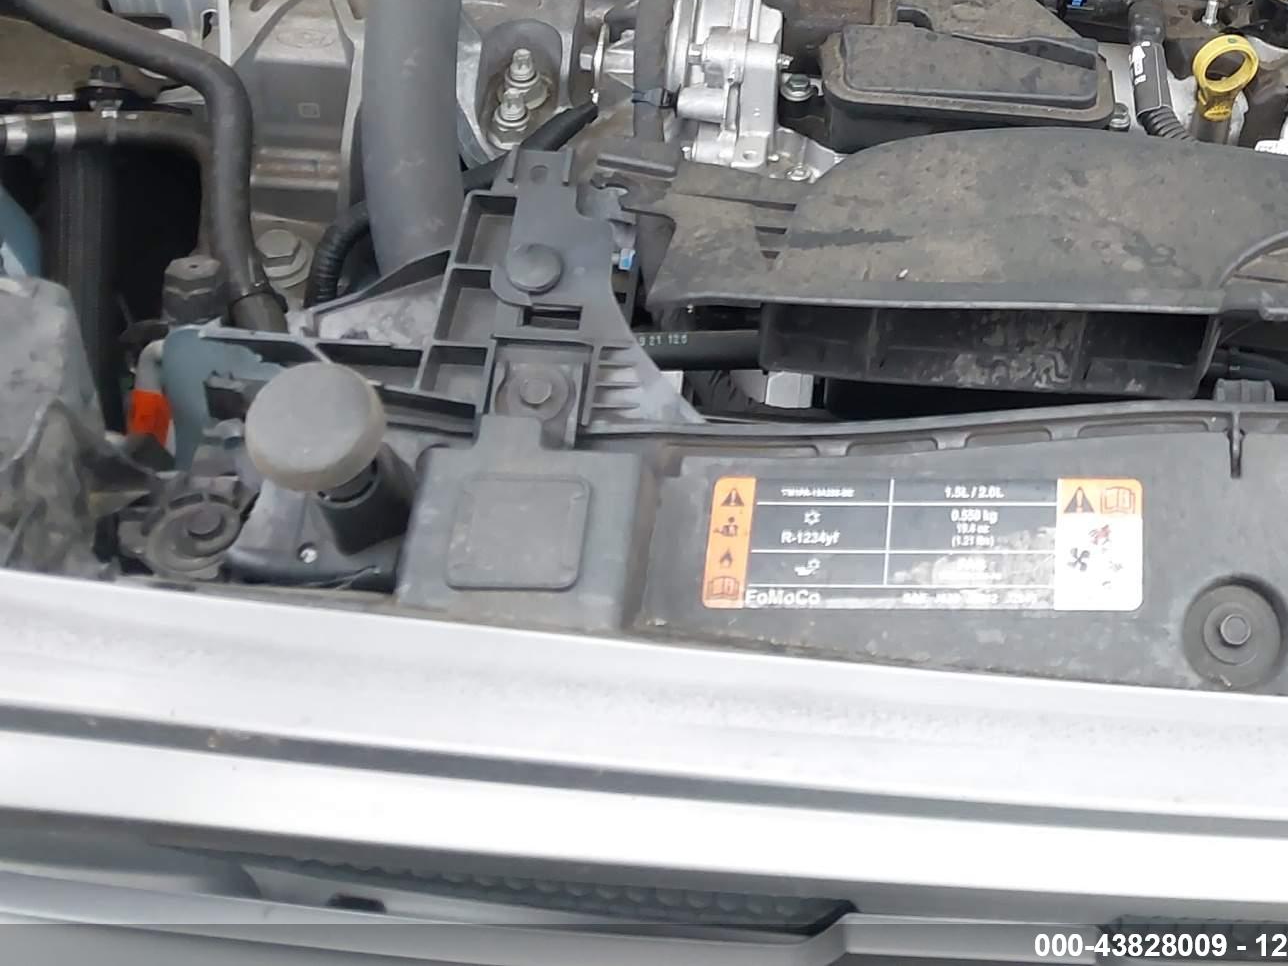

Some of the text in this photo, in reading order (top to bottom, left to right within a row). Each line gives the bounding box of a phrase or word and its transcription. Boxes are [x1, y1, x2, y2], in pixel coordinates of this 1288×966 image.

[978, 485, 1005, 499] 2.0L
[982, 509, 999, 524] kg
[780, 530, 840, 547] R-1234yf
[745, 588, 821, 606] FoMoCo
